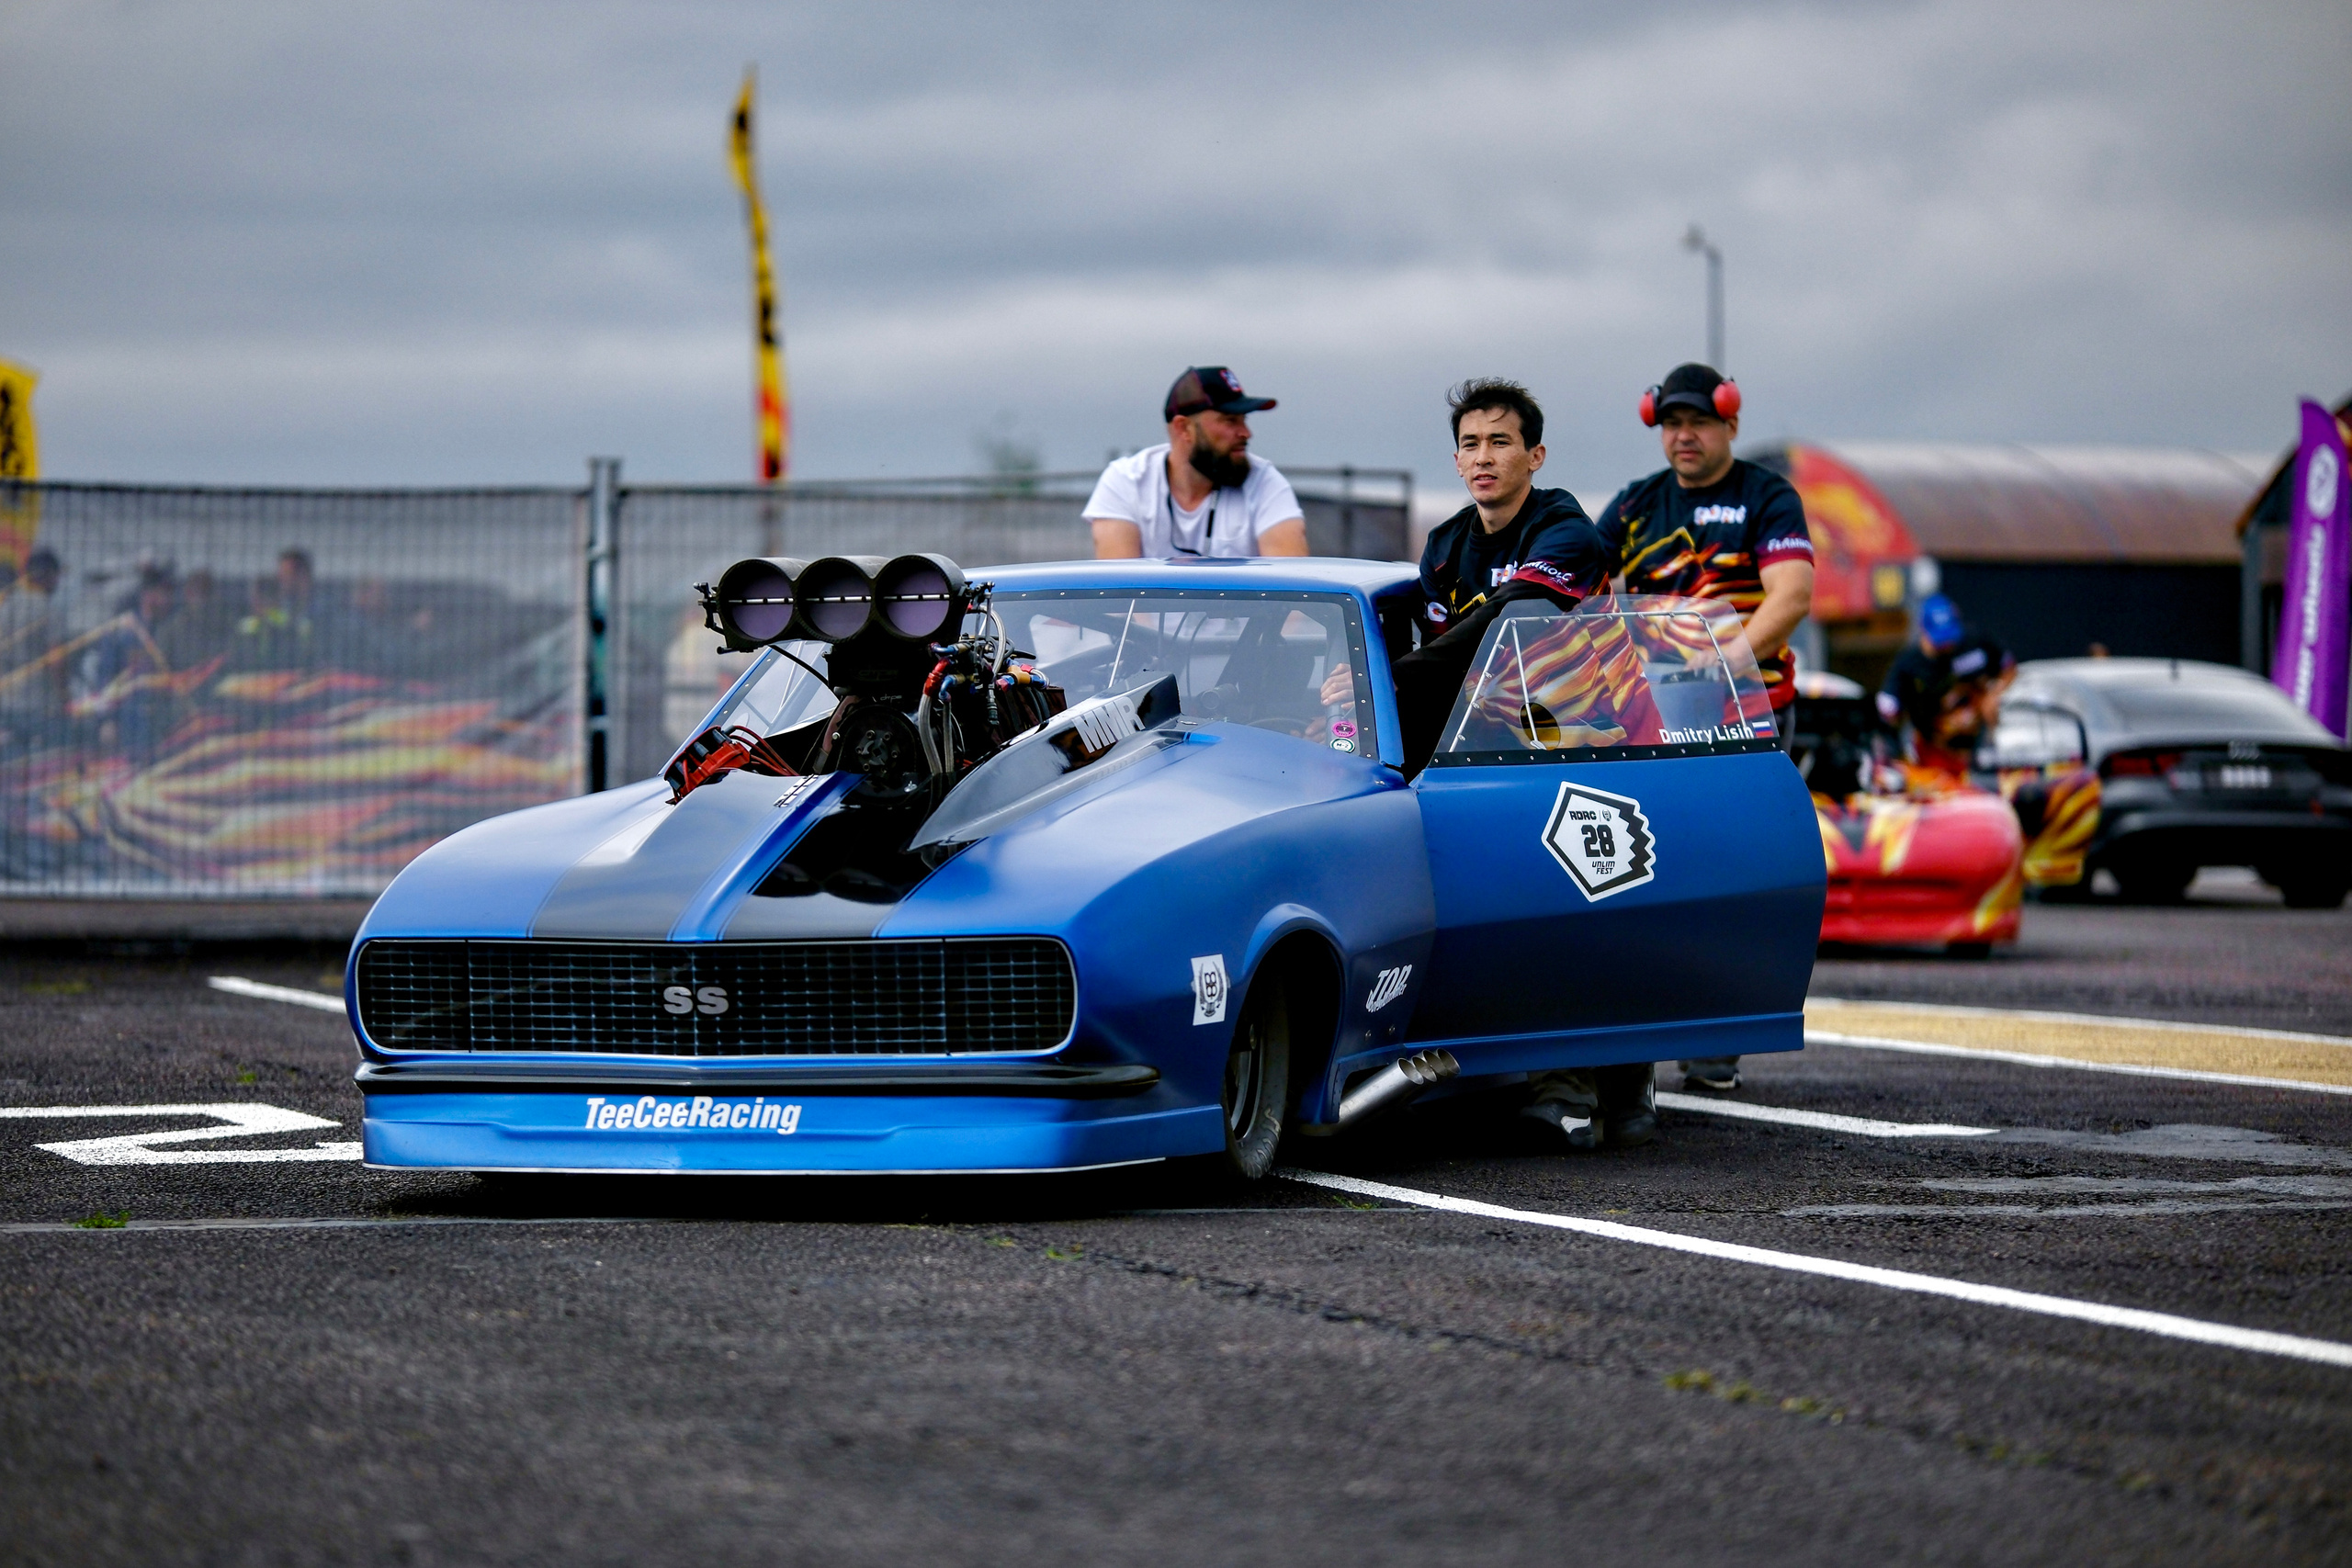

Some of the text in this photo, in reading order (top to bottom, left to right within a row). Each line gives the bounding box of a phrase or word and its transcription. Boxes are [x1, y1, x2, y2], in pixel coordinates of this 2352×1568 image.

[1071, 696, 1146, 753] MMR
[1658, 724, 1754, 745] Dmitry Lisin
[1568, 810, 1597, 820] RDRC
[1581, 825, 1615, 857] 28
[663, 986, 729, 1014] SS
[585, 1096, 802, 1134] TeeCeeRacing
